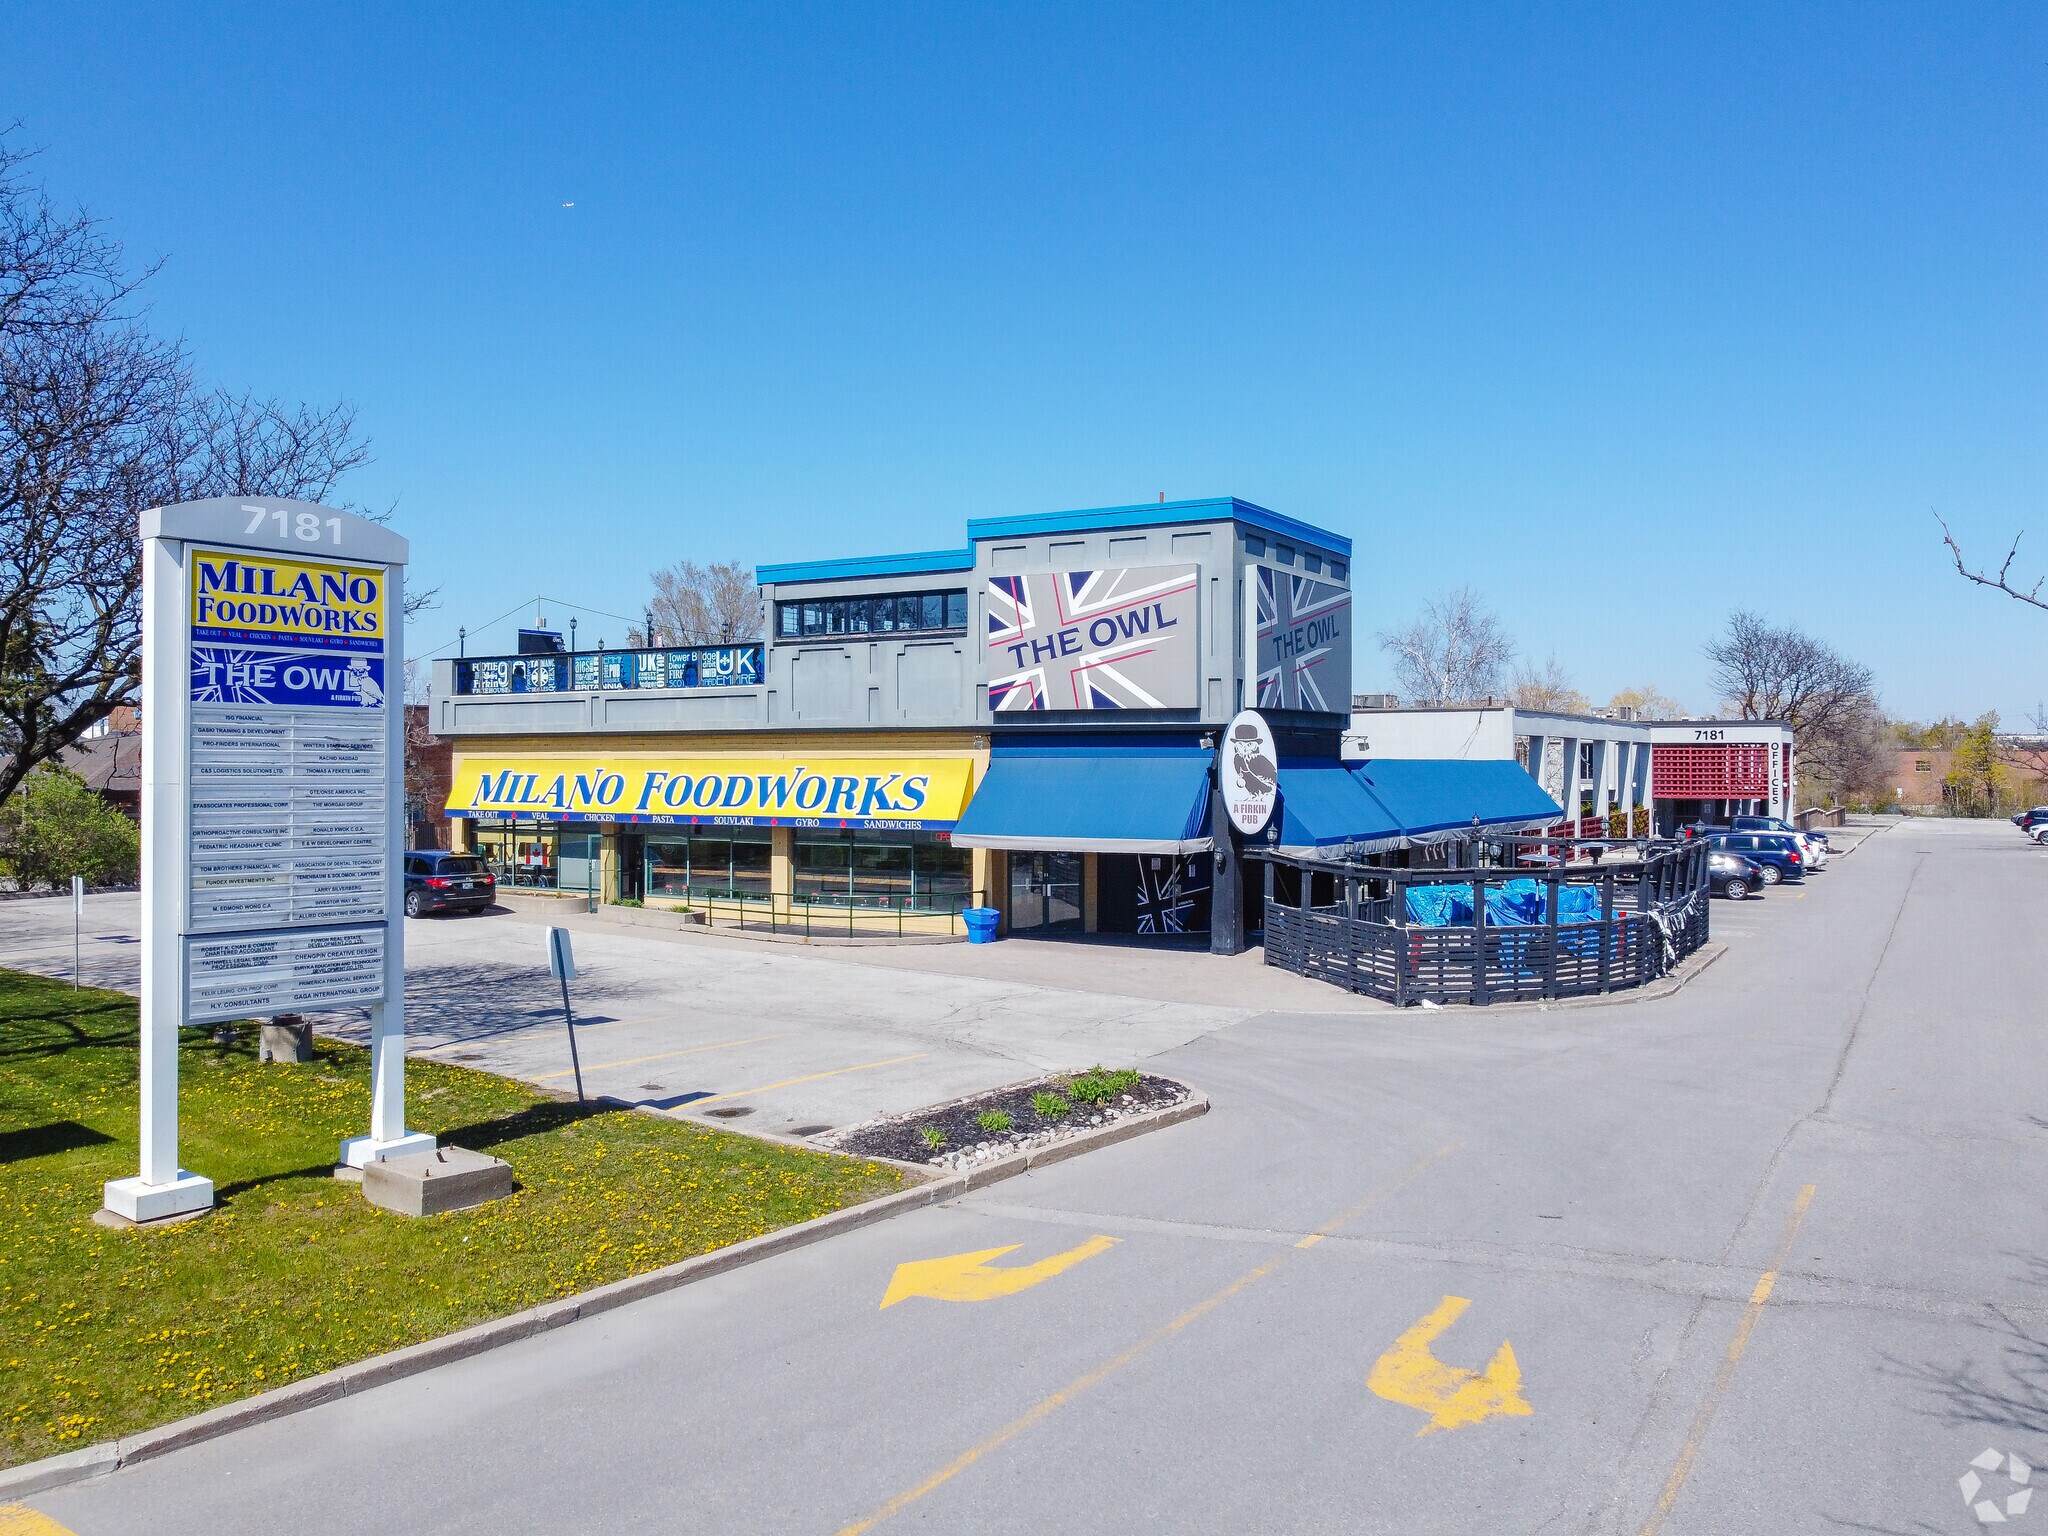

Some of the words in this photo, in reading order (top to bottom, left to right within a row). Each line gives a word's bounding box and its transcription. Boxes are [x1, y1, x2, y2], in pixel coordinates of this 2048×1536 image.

[241, 504, 342, 545] 7181
[197, 560, 378, 606] MILANO
[197, 596, 378, 634] FOODWORKS
[196, 628, 210, 636] TAKE
[249, 632, 271, 640] CHICKEN
[1007, 627, 1084, 670] THE
[1088, 602, 1178, 647] OWL
[1273, 627, 1305, 662] THE
[1306, 614, 1341, 648] OWL
[638, 653, 657, 672] UK
[668, 652, 691, 662] Tower
[716, 648, 756, 675] UK
[201, 662, 277, 688] THE
[283, 665, 361, 692] OWL
[1694, 730, 1724, 741] 7181
[1770, 742, 1780, 805] OFFICES
[470, 768, 626, 811] MILANO
[634, 766, 929, 817] FOODWORKS
[1233, 803, 1239, 814] A
[1240, 803, 1267, 814] FIRKIN
[467, 810, 485, 819] TAKE
[485, 811, 499, 819] OUT
[532, 812, 550, 821] VEAL
[584, 813, 615, 822] CHICKEN
[652, 815, 675, 824] PASTA
[713, 816, 754, 826] SOUVLAKI
[795, 818, 820, 828] GYRO
[863, 819, 922, 830] SANDWICHES
[1241, 814, 1258, 824] PUB
[241, 828, 278, 836] CONSULTANTS
[307, 941, 344, 949] DEVELOPMENT
[294, 953, 326, 961] CHENGPIN
[326, 950, 356, 958] CREATIVE
[351, 958, 382, 966] TECHNOLOGY
[211, 962, 253, 970] PROFESSIONAL
[312, 988, 358, 998] INTERNATIONAL
[359, 985, 381, 994] GROUP
[223, 997, 270, 1008] CONSULTANTS
